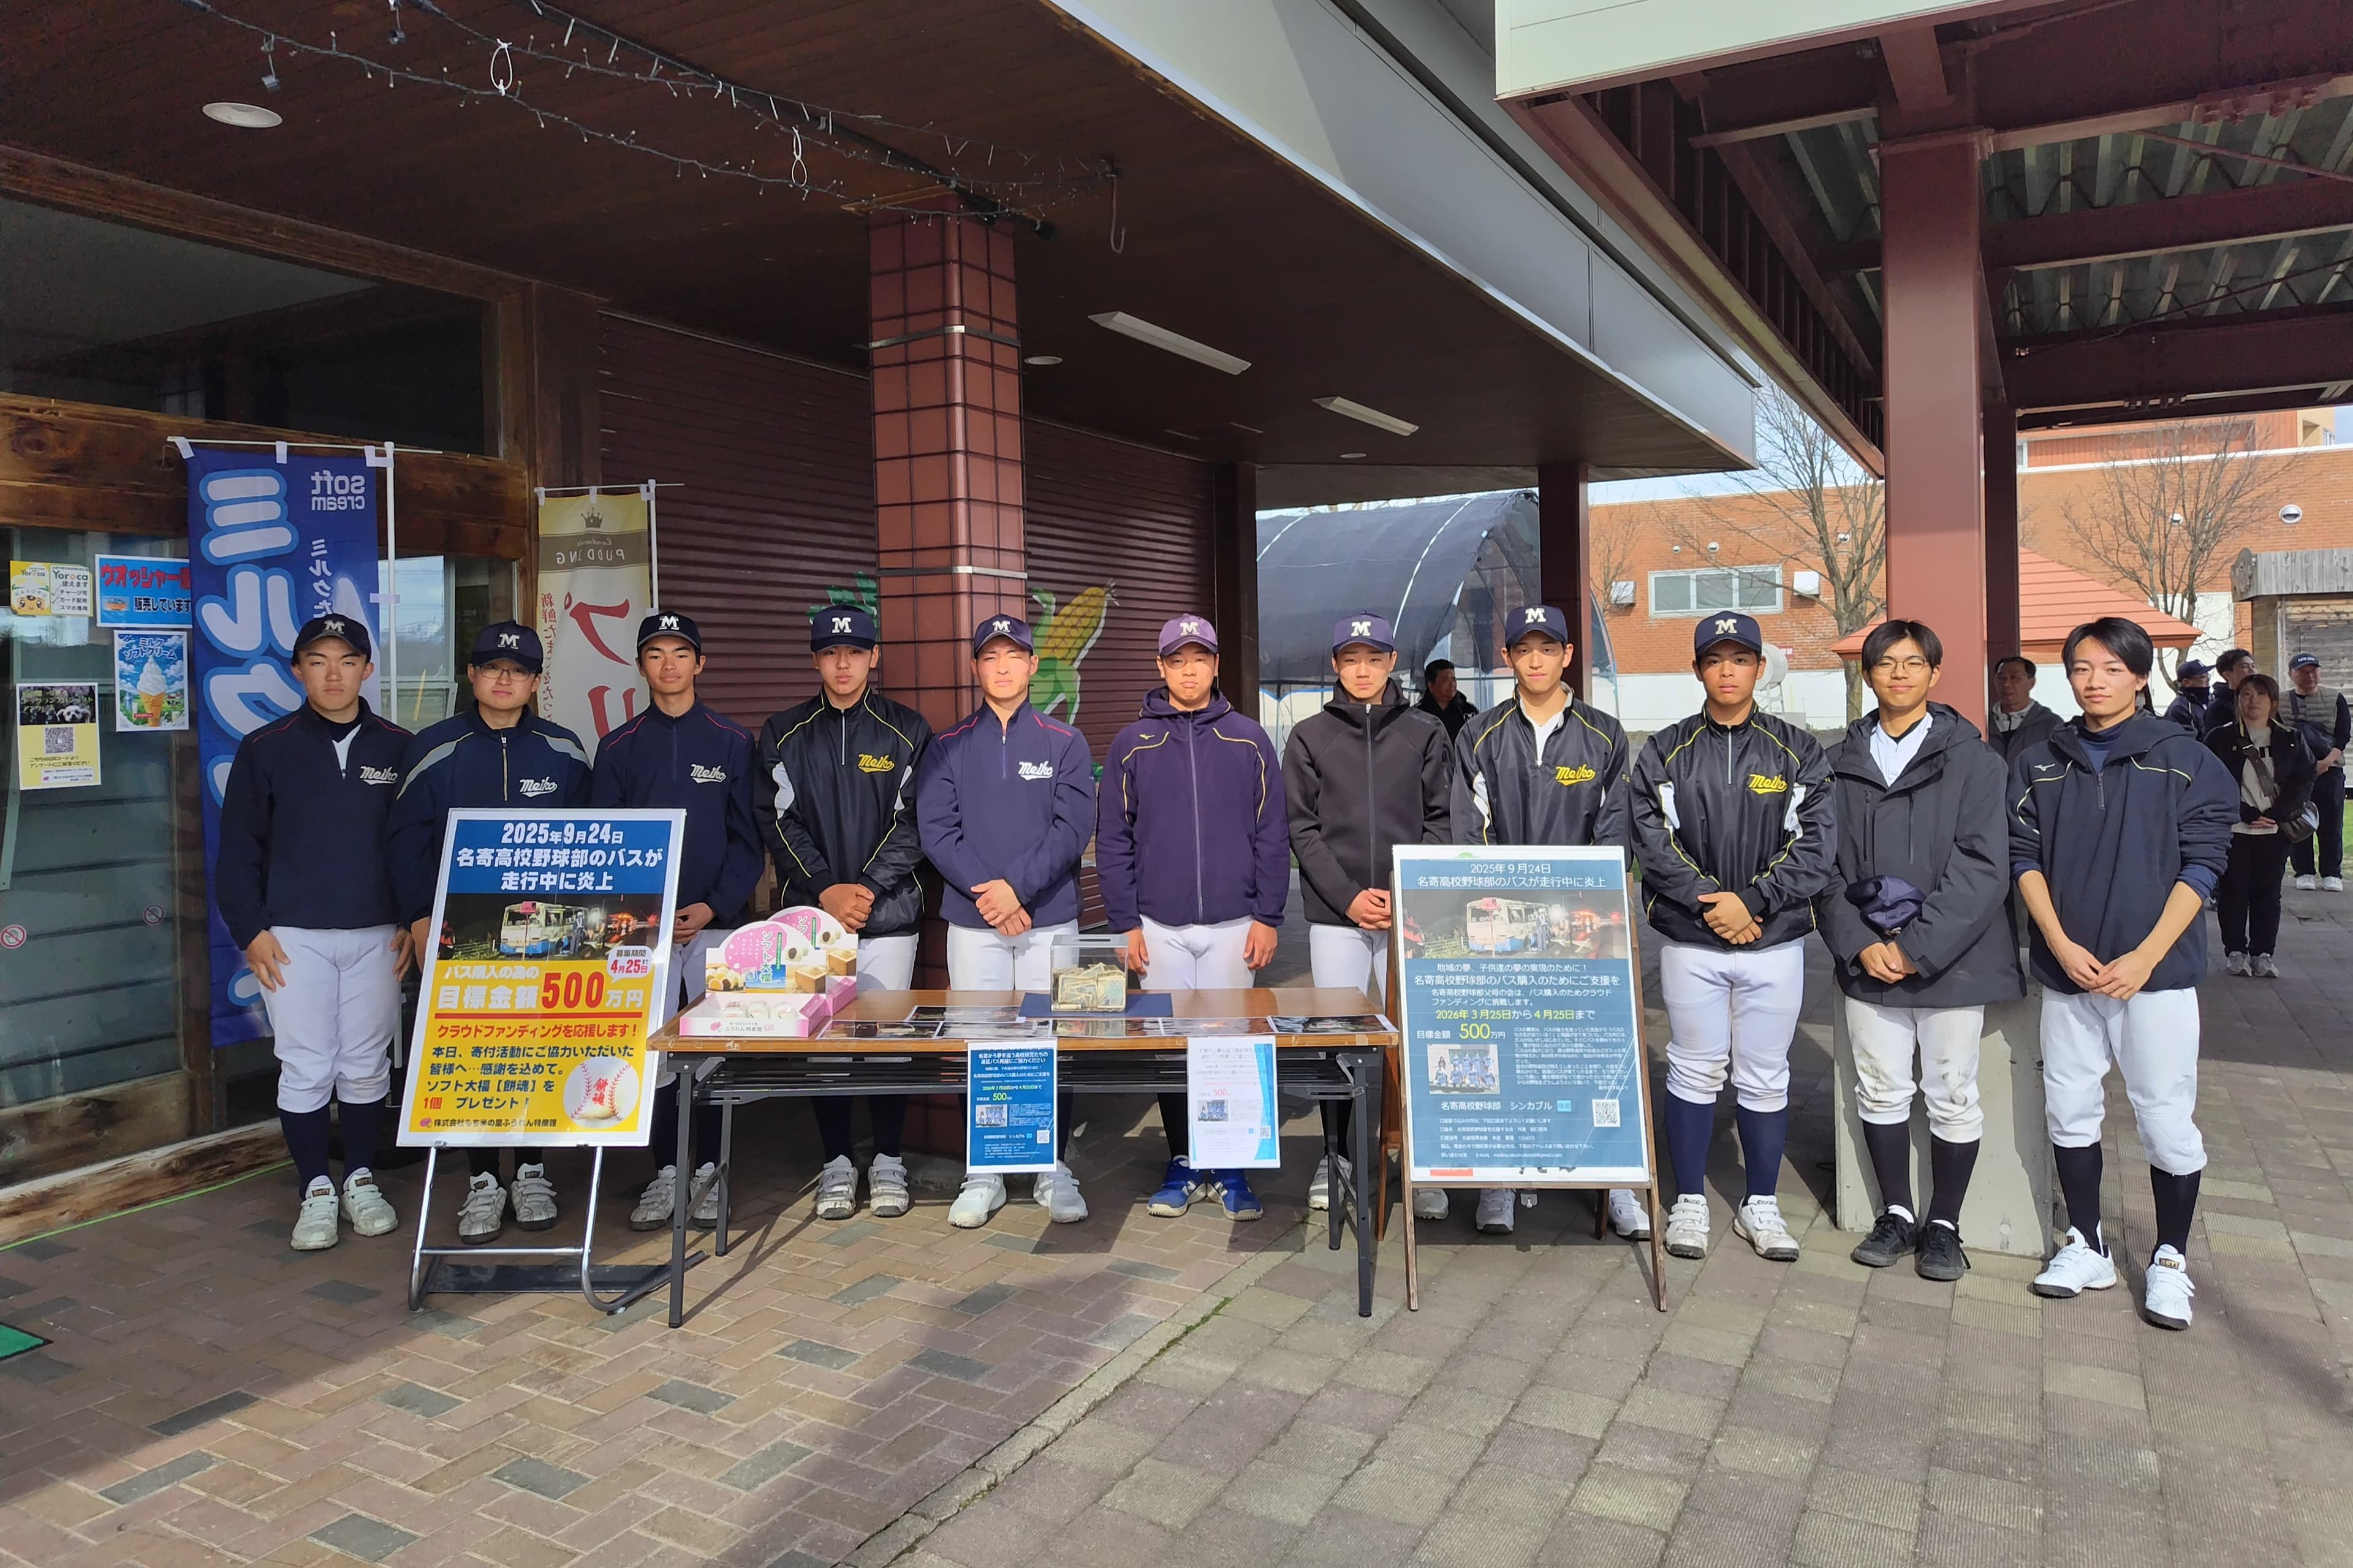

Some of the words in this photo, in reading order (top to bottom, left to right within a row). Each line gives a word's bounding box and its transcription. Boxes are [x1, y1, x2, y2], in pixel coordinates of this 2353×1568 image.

[52, 570, 88, 580] Yoroca
[134, 596, 192, 613] 販売しています
[659, 615, 680, 631] M
[1526, 608, 1547, 624] M
[324, 619, 345, 634] M
[832, 617, 852, 634] M
[992, 620, 1010, 632] M
[1180, 622, 1200, 635] M
[1351, 621, 1371, 637] M
[1716, 619, 1738, 634] M
[139, 637, 164, 648] ミルク
[498, 633, 520, 650] M
[124, 647, 177, 660] ソフトクリーム
[858, 754, 895, 769] Meiko
[1018, 760, 1053, 778] Meiko
[359, 765, 398, 783] Meiko
[691, 763, 727, 781] Meiko
[1555, 765, 1596, 782] Meiko
[519, 776, 558, 793] Meiko
[1749, 773, 1787, 790] Meiko
[501, 822, 623, 844] 2025年9月24日
[457, 847, 664, 868] 名寄高校野球部のバスが
[501, 871, 613, 891] 走行中に炎上
[1417, 876, 1607, 888] 名寄高校野球部のバスが走行中に炎上
[760, 931, 773, 983] ソフト大福
[444, 964, 539, 980] バス購入の為の
[1414, 975, 1621, 987] 名寄高校野球部のバス購入のためにご支援を
[1431, 998, 1534, 1007] ファンディングに挑戦します。
[1417, 1031, 1451, 1040] 目標金額
[431, 1045, 635, 1059] 本日、寄付活動にご協力いただいた
[422, 1097, 442, 1110] 1個
[1441, 1101, 1501, 1111] 名寄高校野球部
[1509, 1101, 1553, 1111] シンカブル
